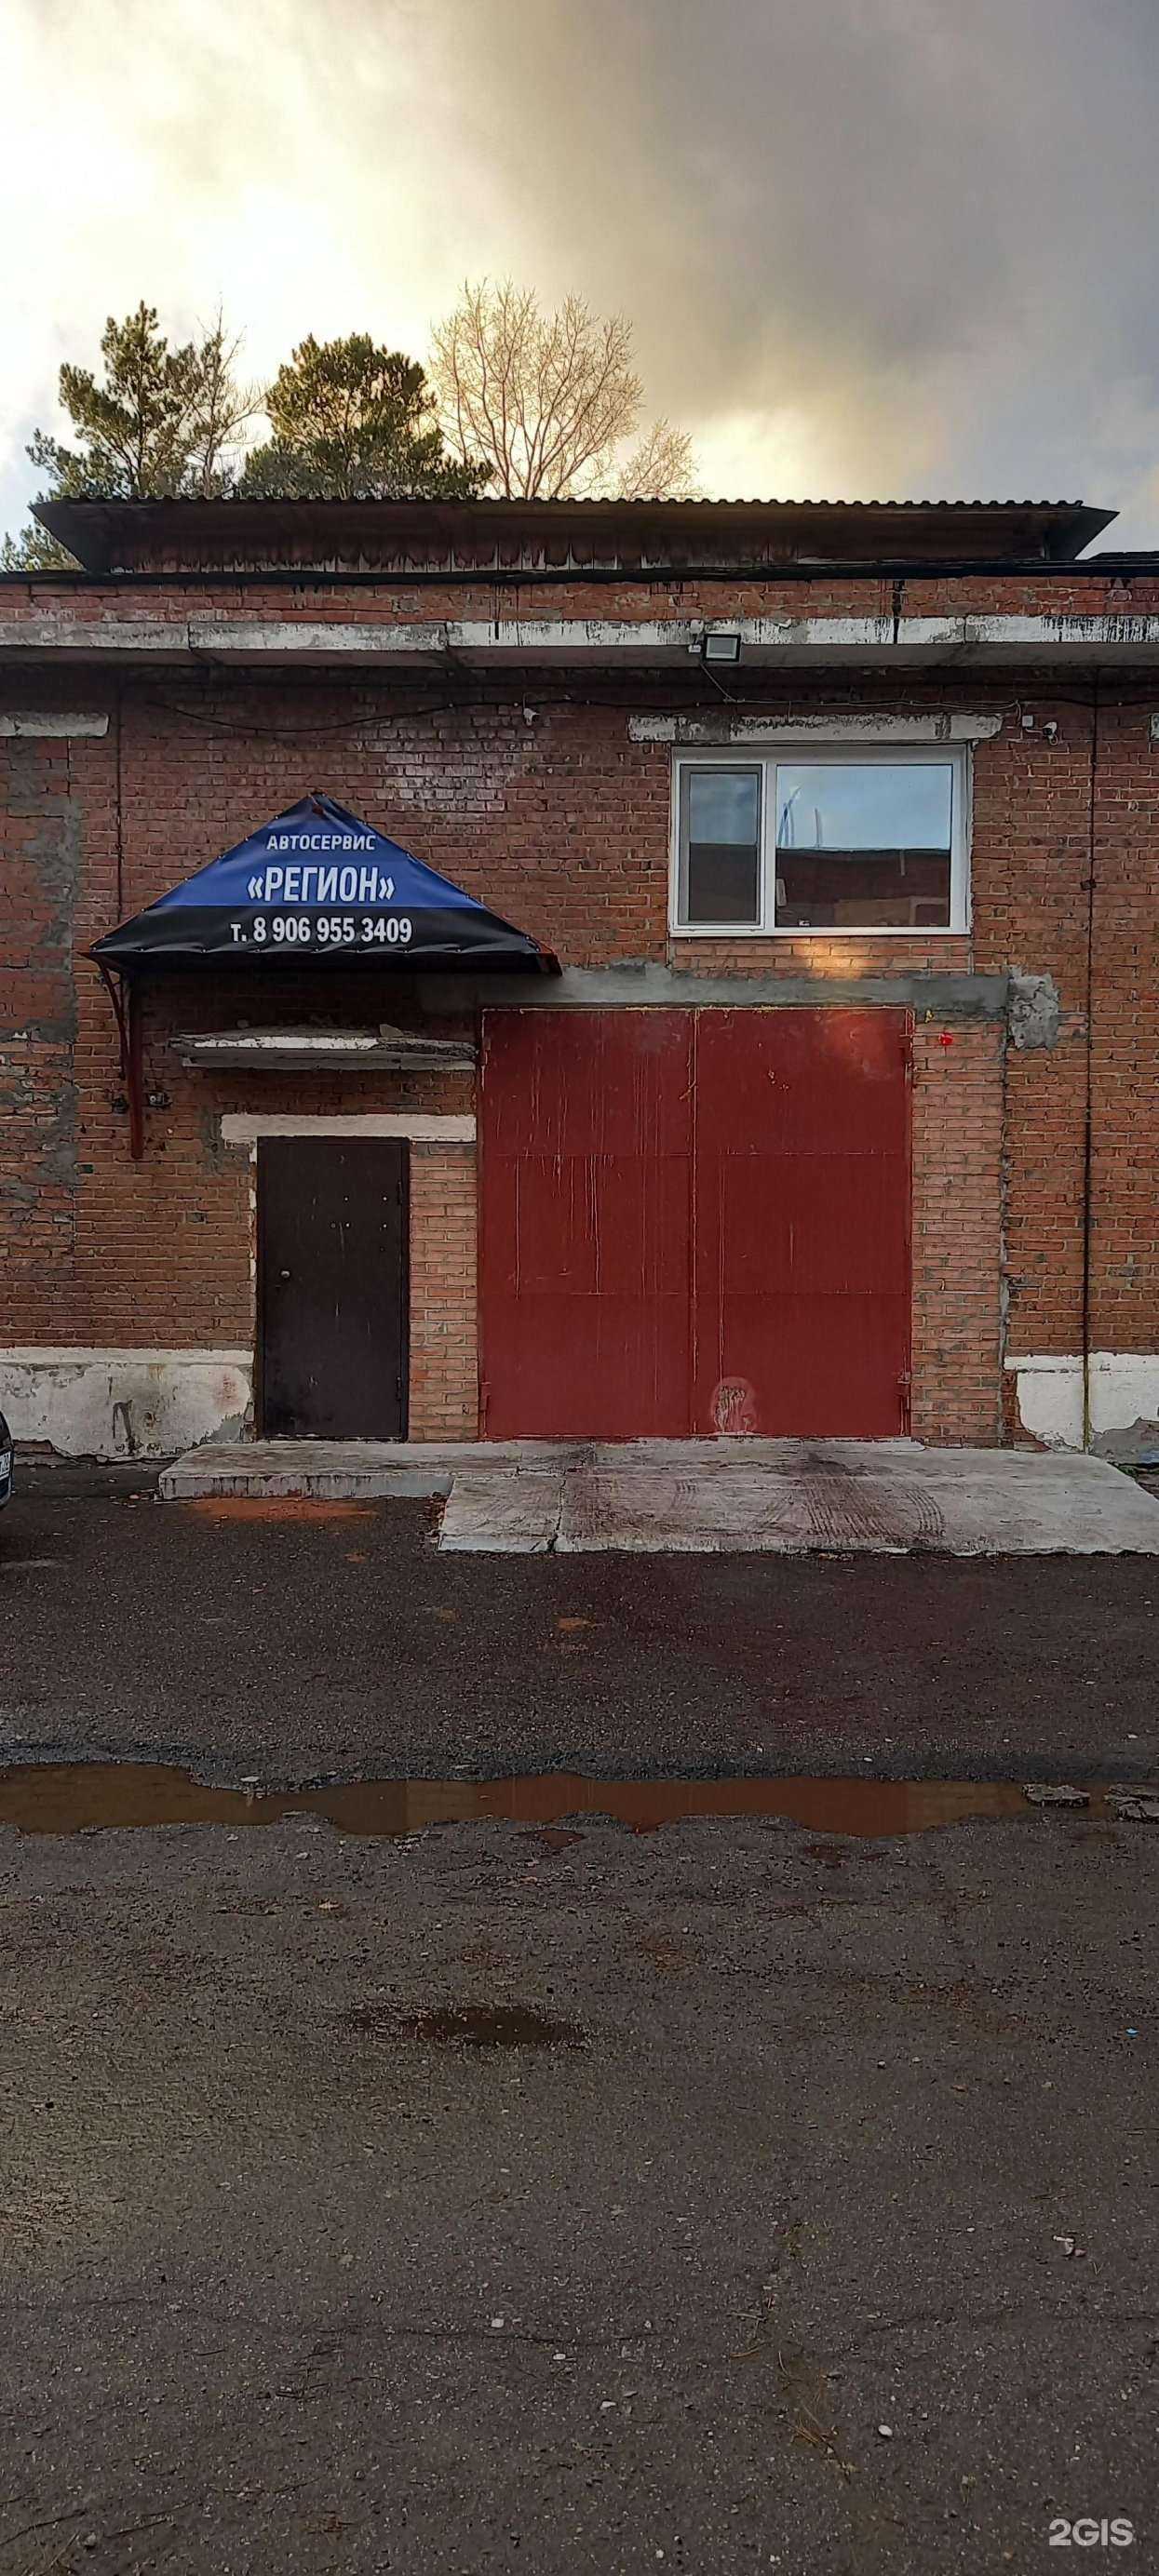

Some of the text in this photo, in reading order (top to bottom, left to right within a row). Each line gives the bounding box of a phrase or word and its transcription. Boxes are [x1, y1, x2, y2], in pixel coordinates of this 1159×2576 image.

[266, 834, 376, 851] АВТОСЕРВИС
[247, 865, 396, 903] «РЕГИОН»
[230, 917, 412, 944] т. 8 906 955 3409
